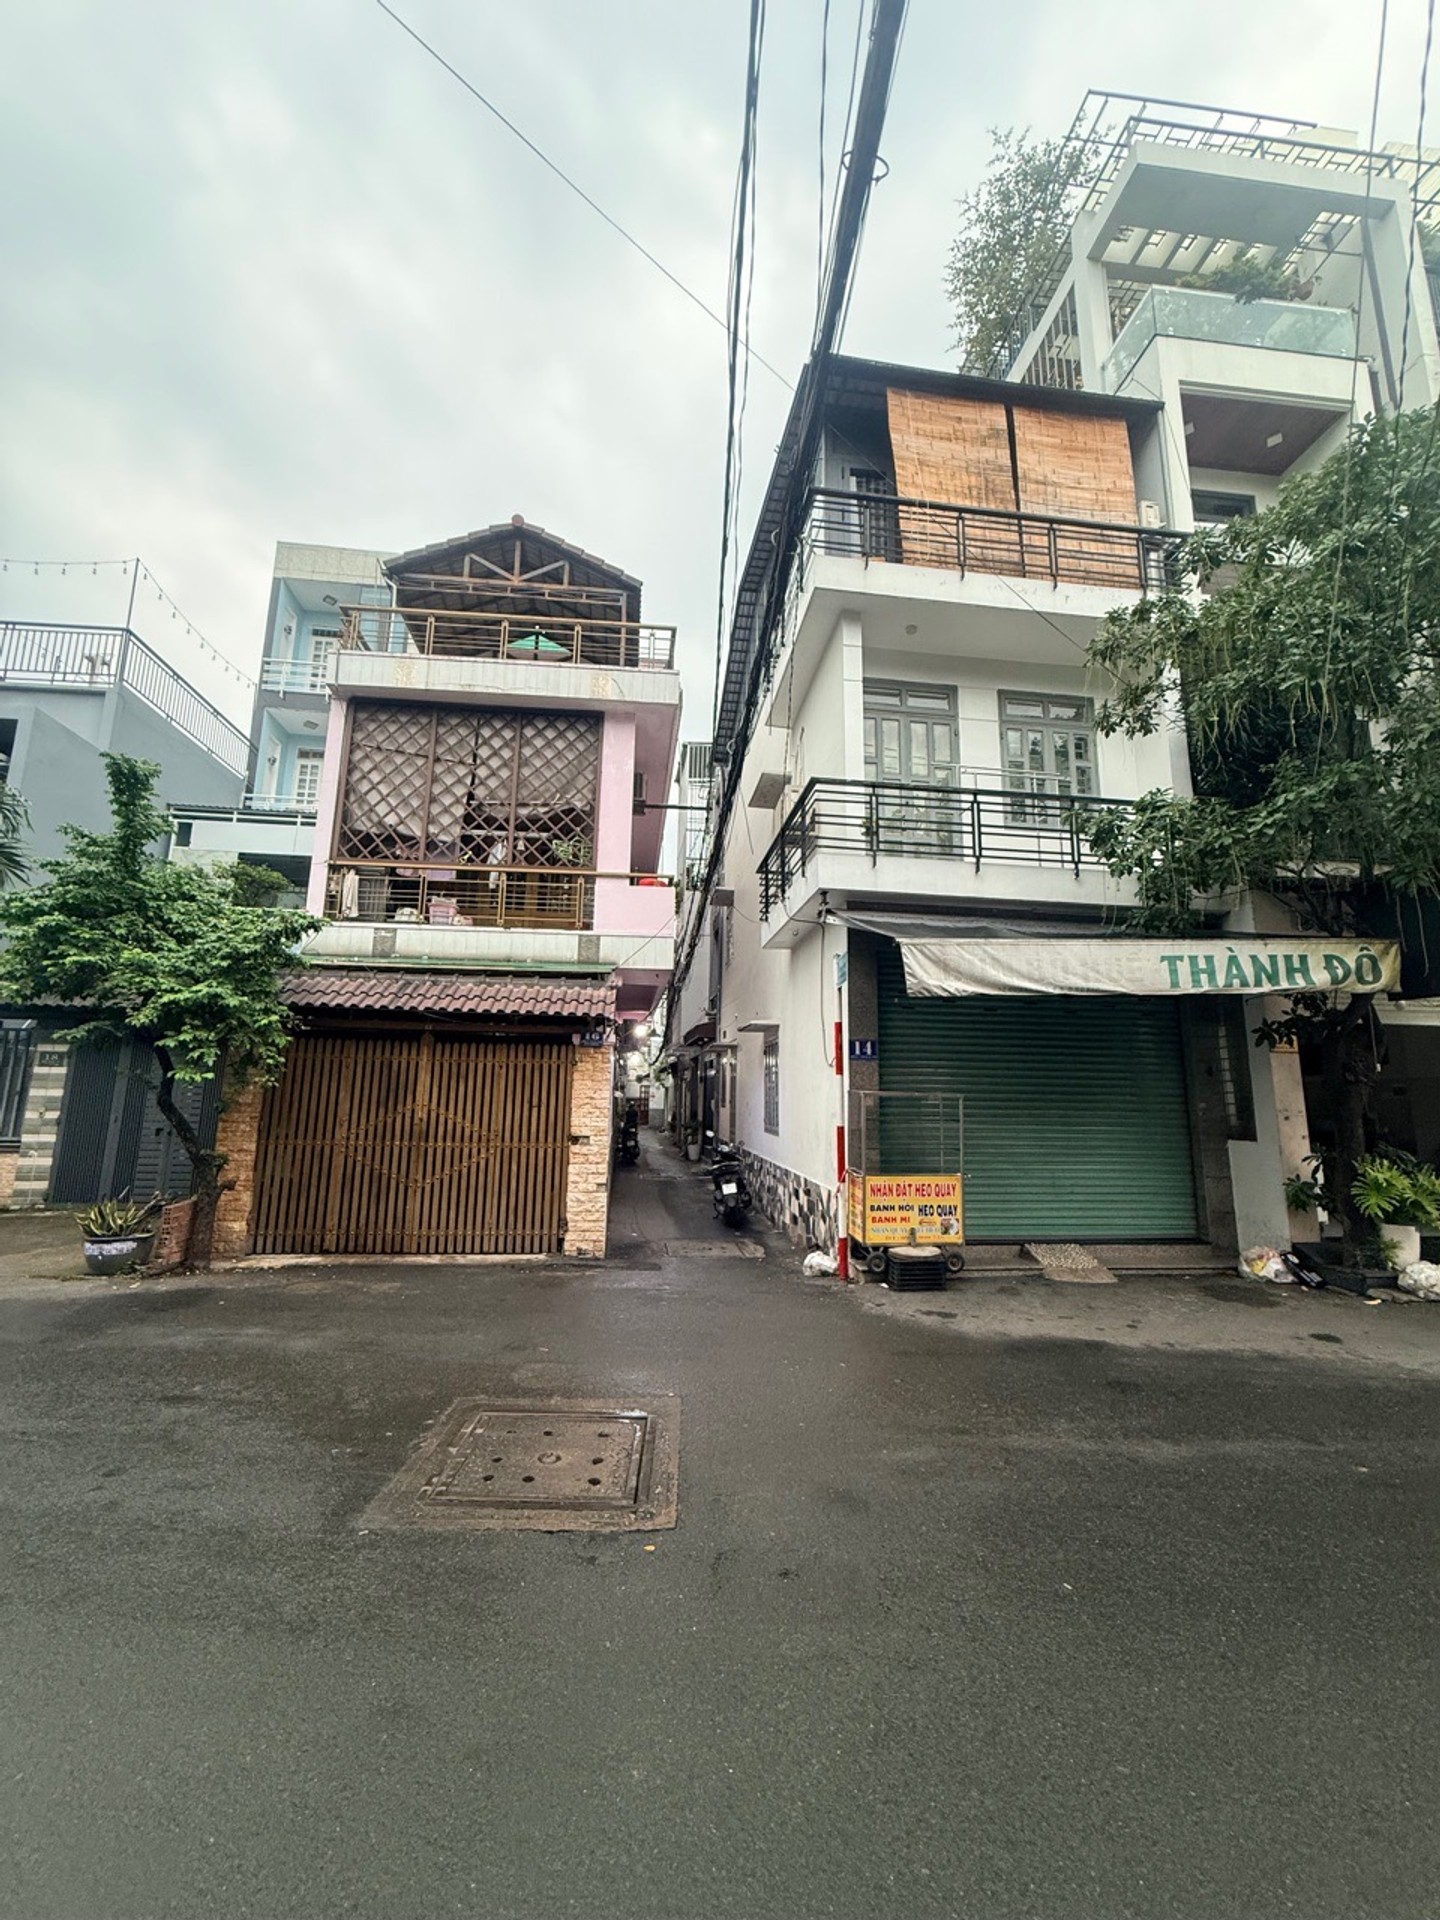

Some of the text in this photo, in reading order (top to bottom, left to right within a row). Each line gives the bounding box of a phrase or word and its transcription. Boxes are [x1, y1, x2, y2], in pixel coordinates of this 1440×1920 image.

[1159, 946, 1317, 989] THÀNH
[1322, 943, 1383, 986] ĐÔ
[855, 1040, 873, 1055] 14
[915, 1183, 932, 1198] HEO
[934, 1183, 957, 1198] QUAY
[918, 1204, 958, 1218] HEO QUAY
